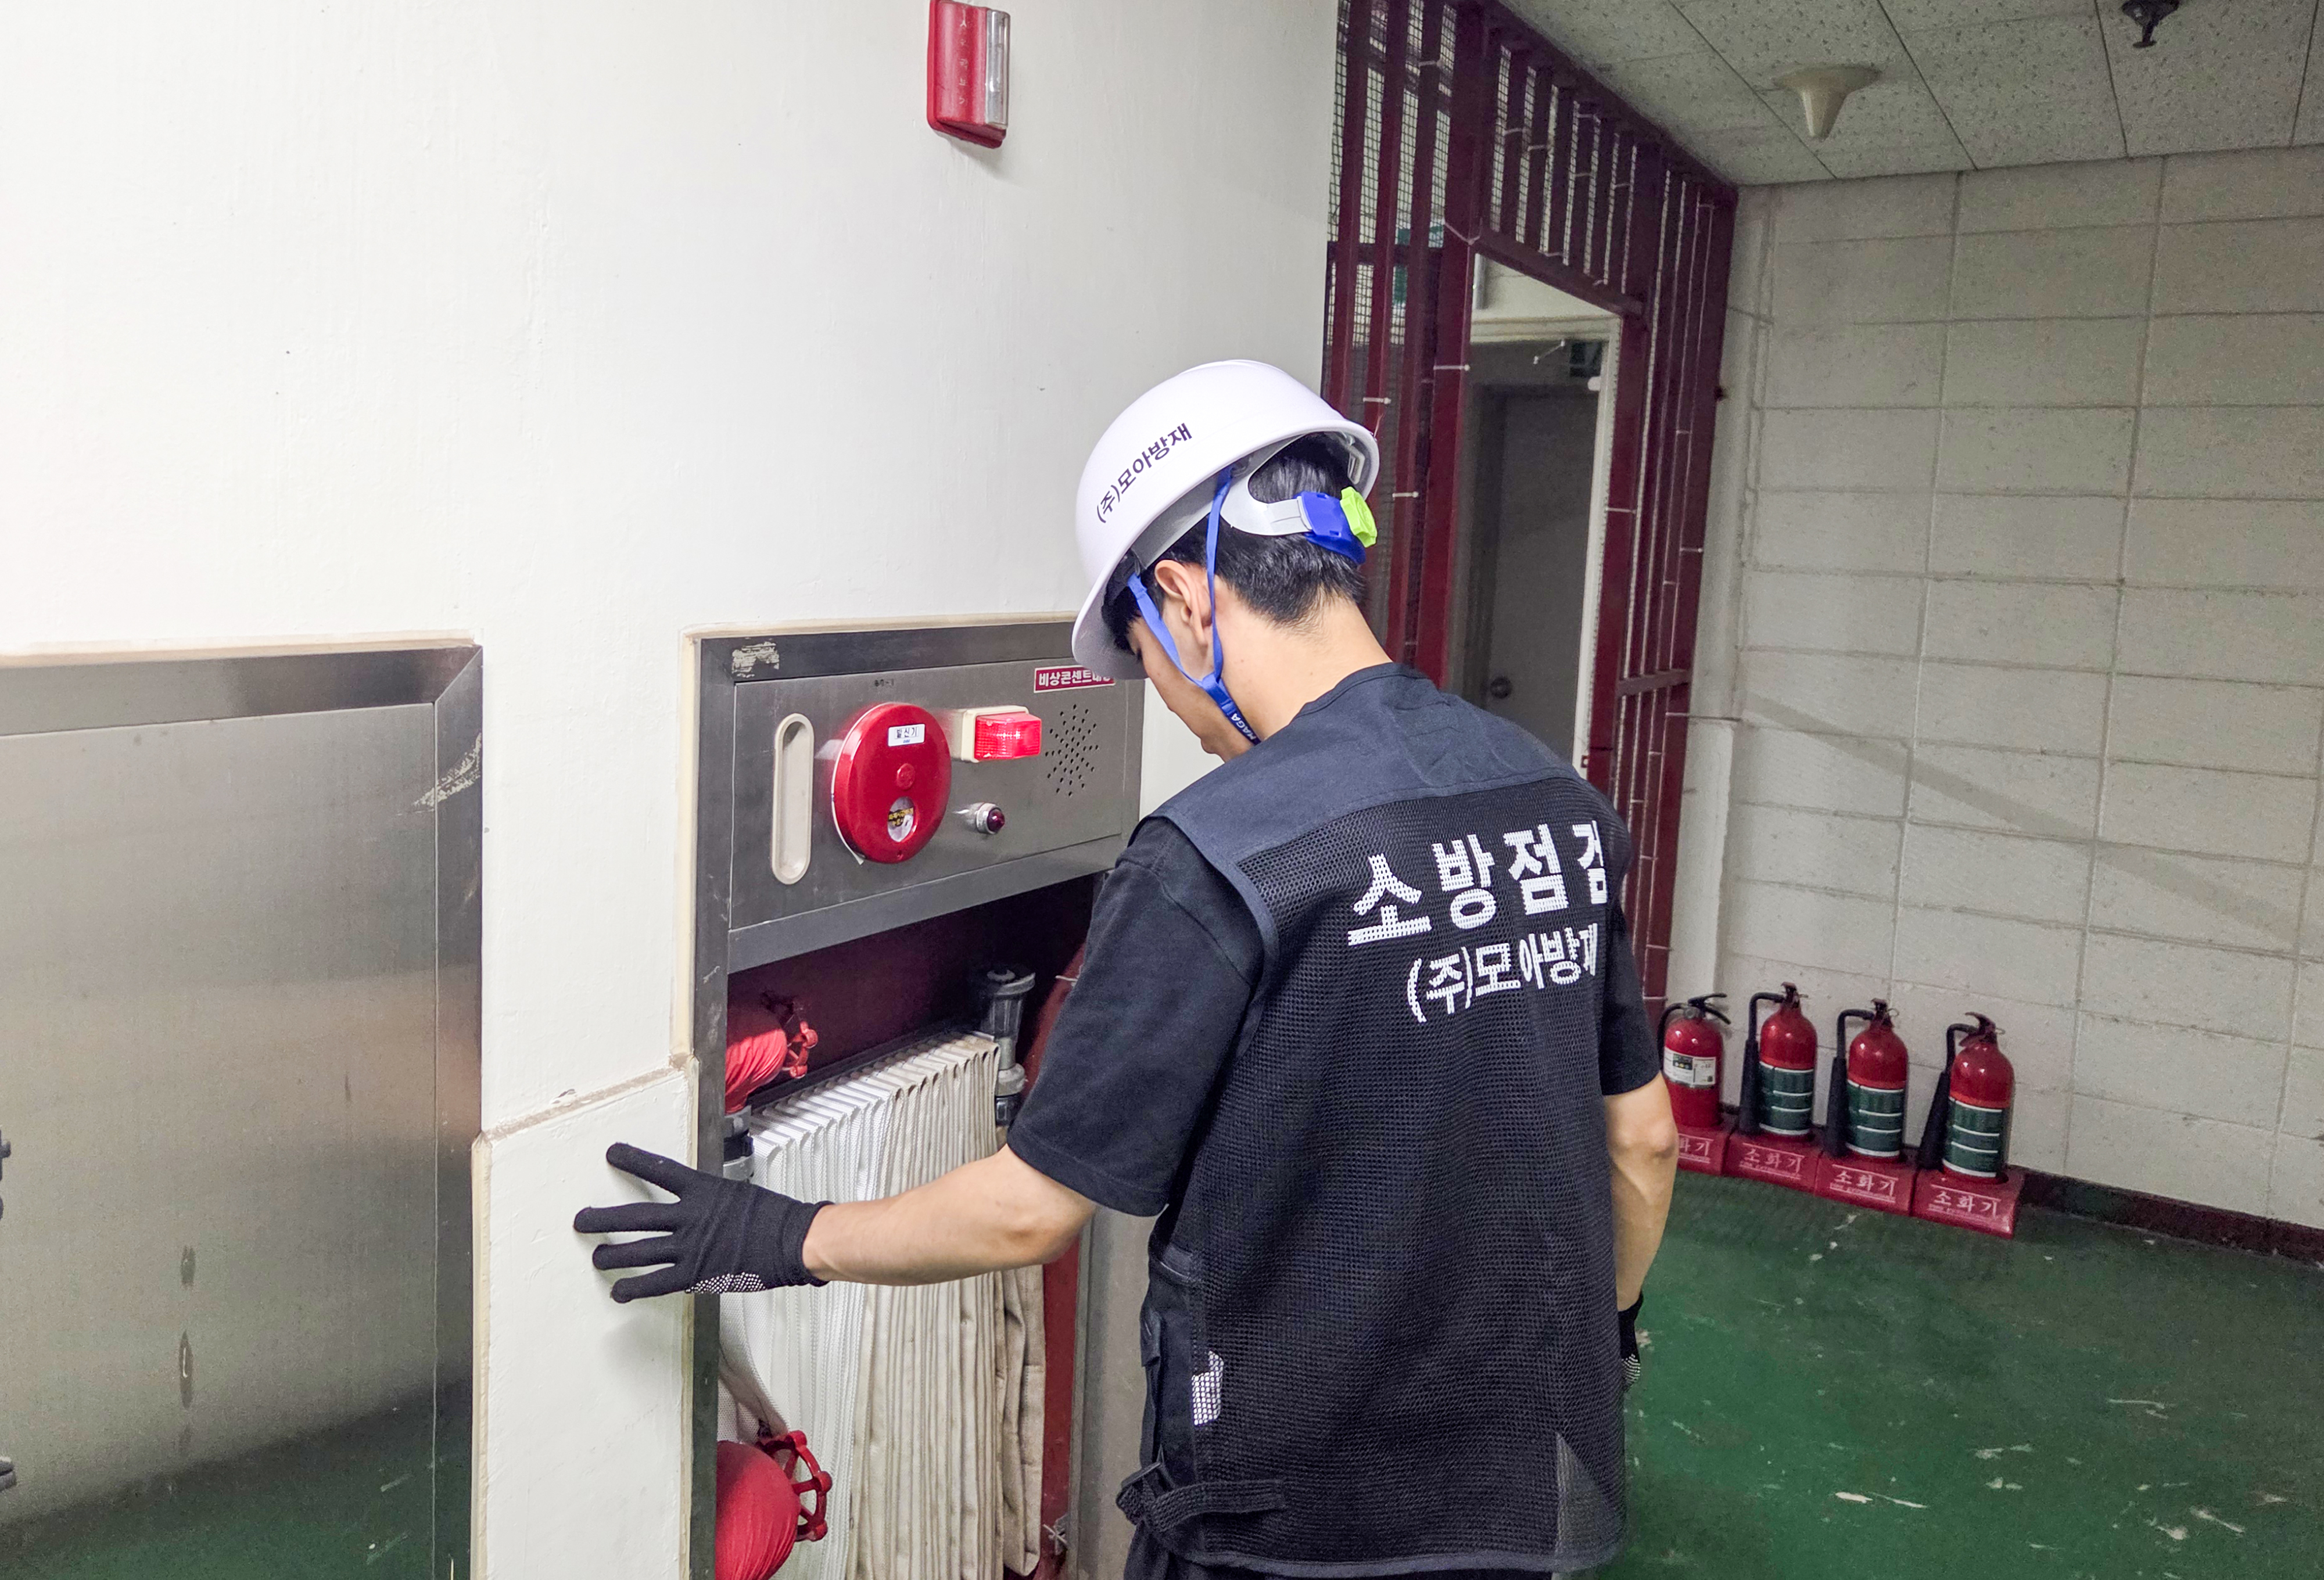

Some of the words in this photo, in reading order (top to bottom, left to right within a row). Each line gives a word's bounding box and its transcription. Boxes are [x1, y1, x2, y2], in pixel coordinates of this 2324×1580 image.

[1097, 423, 1192, 523] (주)모아방재
[896, 727, 917, 738] 발신기
[1679, 1137, 1710, 1156] 화기
[1744, 1148, 1802, 1173] 소화기
[1834, 1170, 1895, 1197] 소화기
[1934, 1191, 1997, 1218] 소화기
